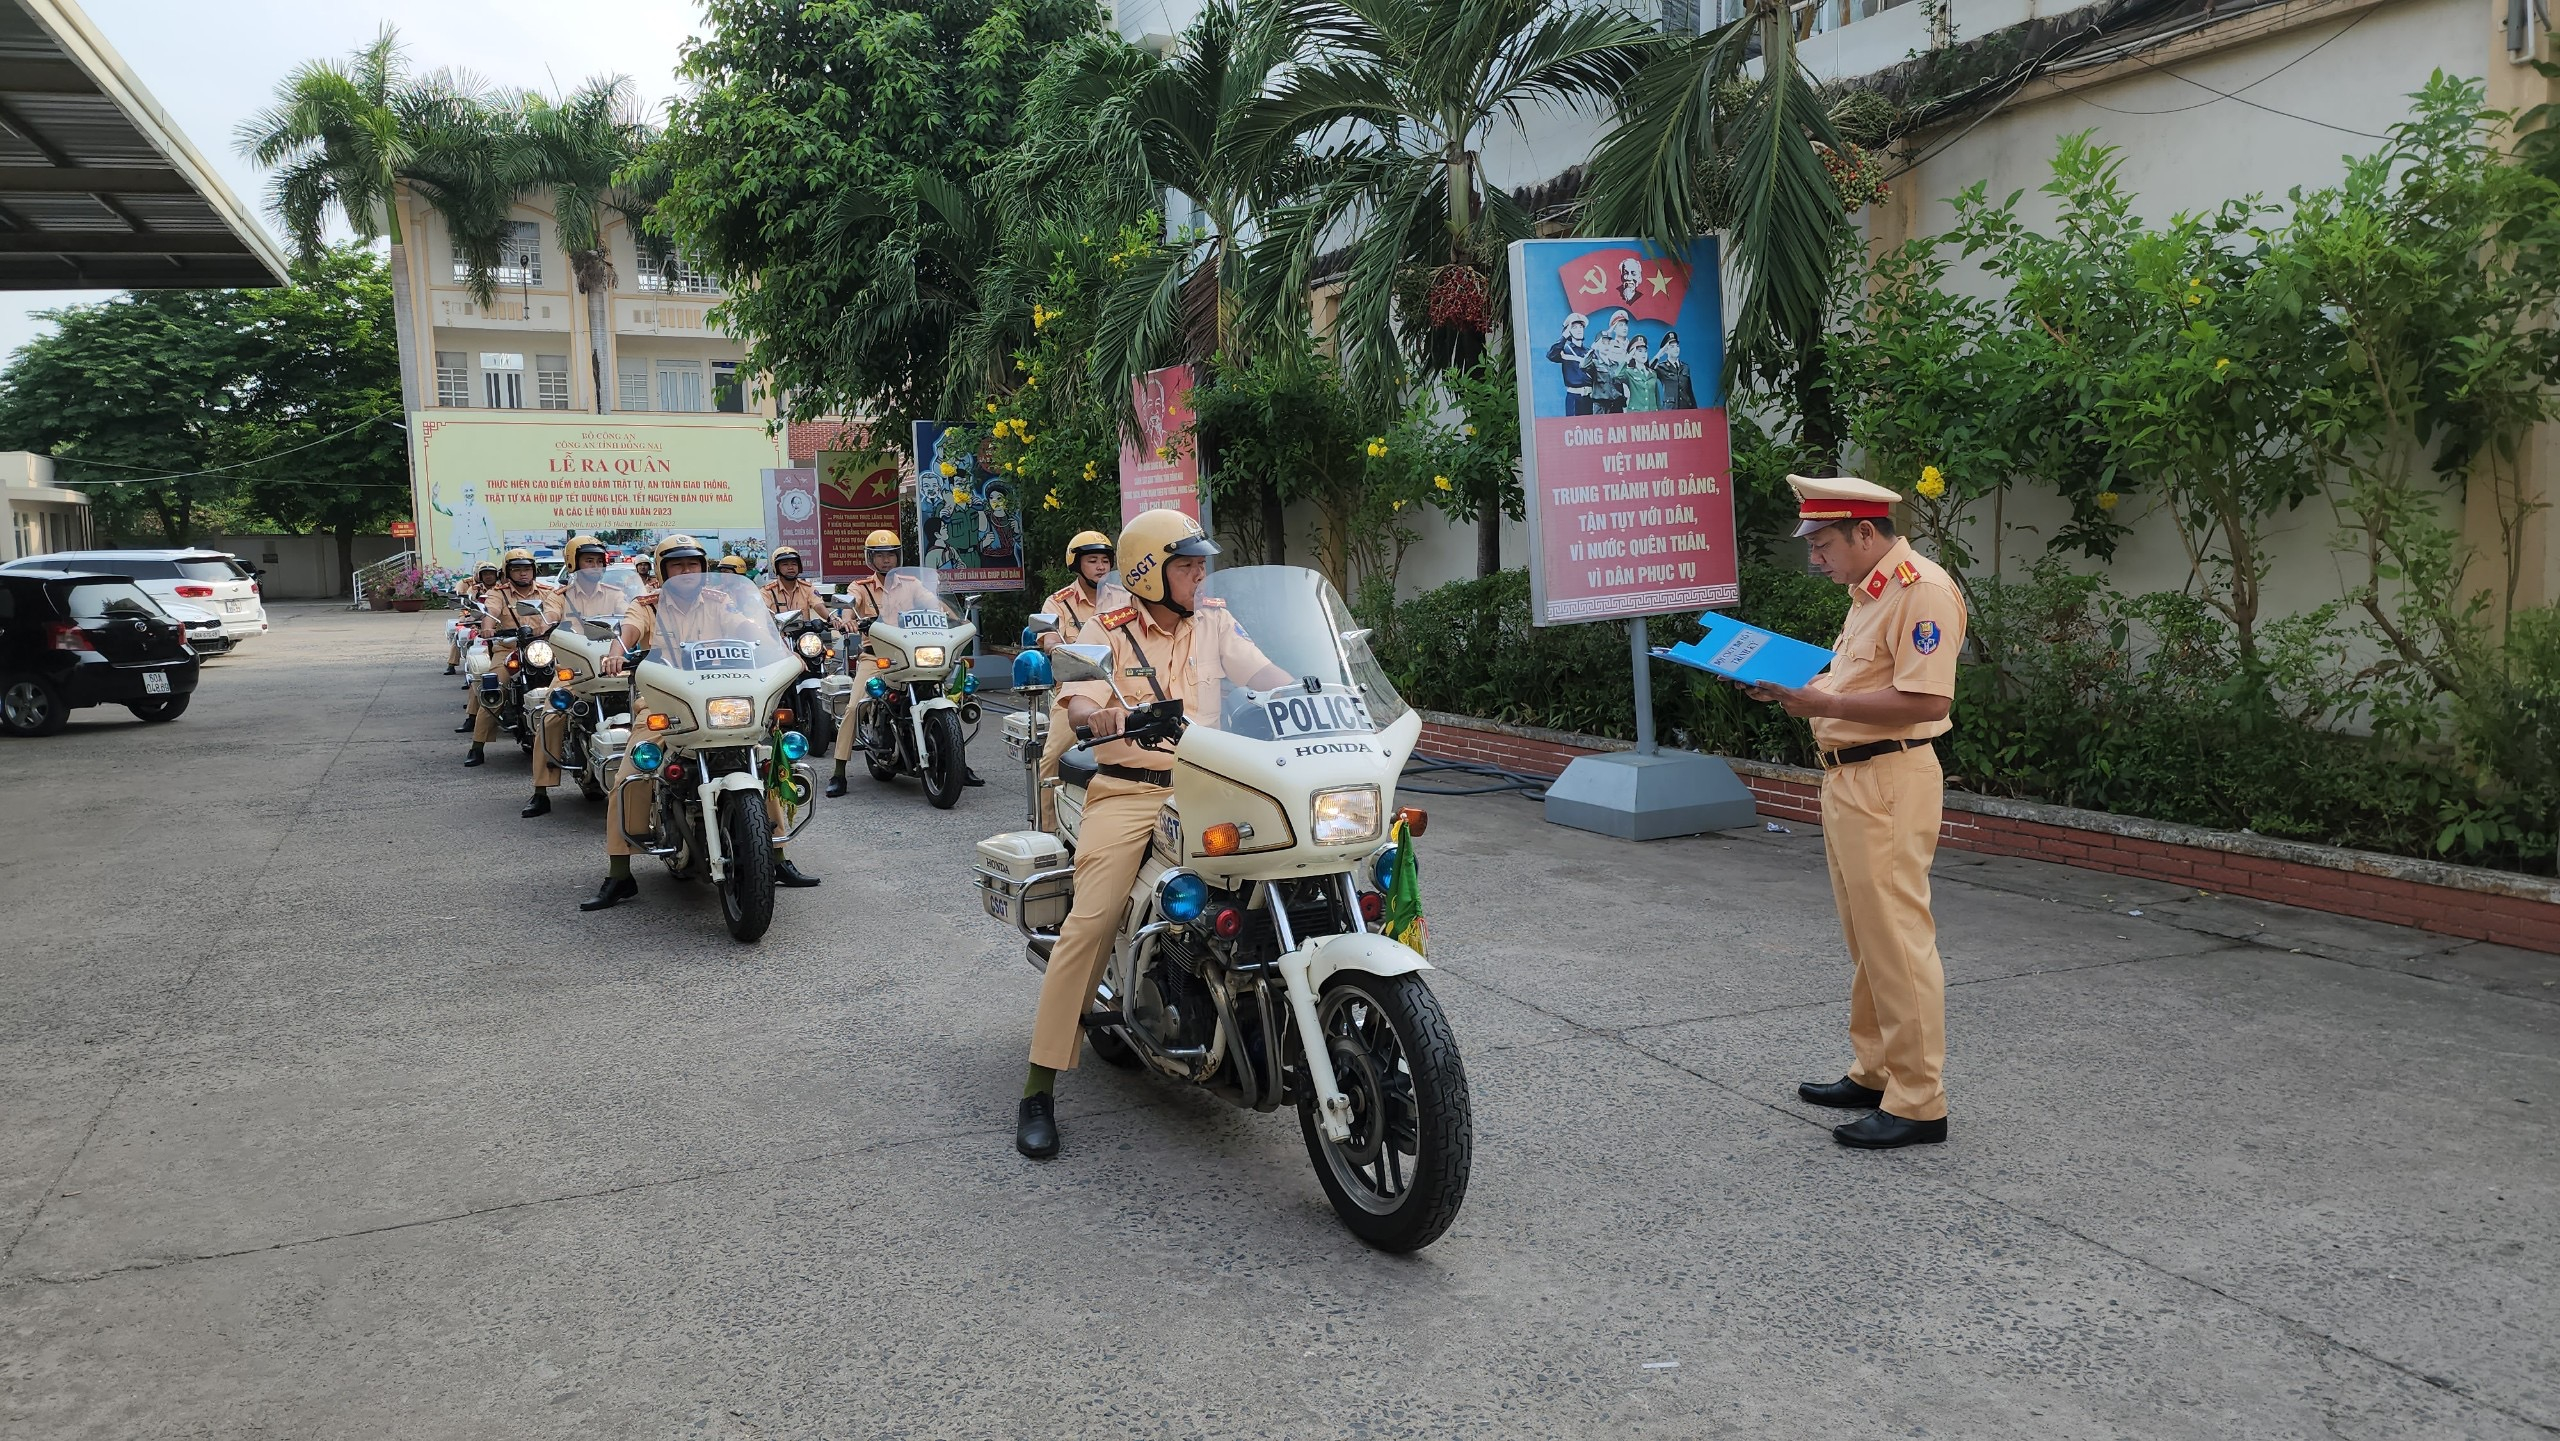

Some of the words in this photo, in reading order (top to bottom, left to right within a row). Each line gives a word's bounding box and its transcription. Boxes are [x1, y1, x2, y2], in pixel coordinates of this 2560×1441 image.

[1564, 425, 1604, 447] CÔNG
[1607, 426, 1627, 444] AN
[1630, 420, 1670, 442] NHÂN
[1673, 418, 1703, 440] DÂN
[549, 451, 576, 473] LỄ
[582, 459, 609, 473] RA
[614, 455, 671, 476] QUÂN
[1602, 451, 1632, 475] VIỆT
[1635, 452, 1668, 470] NAM
[532, 480, 548, 489] CAO
[648, 480, 658, 489] AN
[683, 480, 701, 489] GIAO
[1552, 486, 1600, 506] TRUNG
[1603, 479, 1649, 501] THÀNH
[1651, 476, 1675, 498] VỚI
[1678, 472, 1720, 497] ĐẢNG,
[630, 505, 651, 516] XUÂN
[653, 507, 672, 516] 2023
[1578, 511, 1607, 535] TẬN
[1610, 511, 1635, 532] TỤY
[1639, 505, 1662, 527] VỚI
[1665, 503, 1698, 526] DÂN,
[1569, 540, 1584, 561] VÌ
[1587, 537, 1626, 560] NƯỚC
[1629, 533, 1667, 557] QUÊN
[1670, 530, 1711, 552] THÂN,
[1126, 553, 1157, 587] CSGT
[1587, 567, 1602, 588] VÌ
[1605, 565, 1635, 587] DÂN
[1638, 563, 1674, 585] PHỤC
[1678, 562, 1696, 582] VỤ
[904, 614, 947, 627] POLICE
[695, 647, 751, 660] POLICE
[701, 672, 752, 680] HONDA
[1267, 695, 1374, 736] POLICE
[1295, 743, 1374, 757] HONDA
[985, 857, 1011, 875] HONDA
[990, 894, 1009, 918] CSGT
